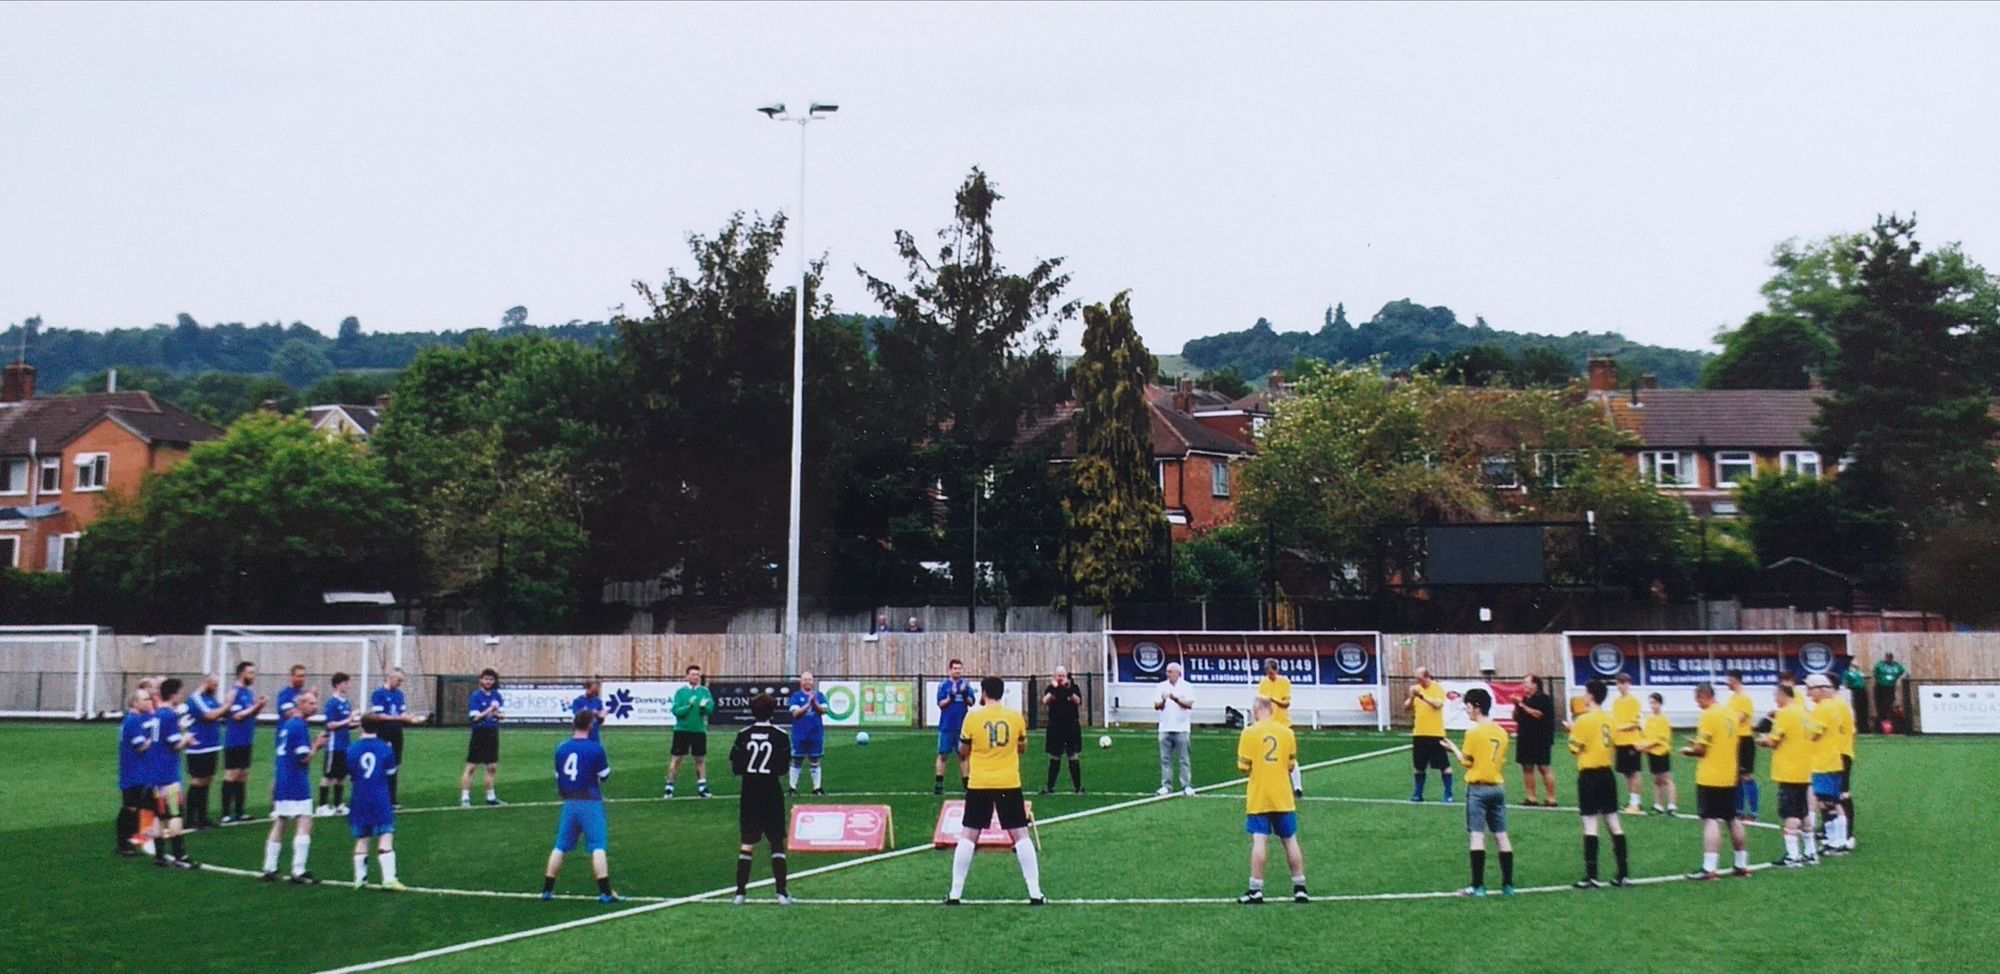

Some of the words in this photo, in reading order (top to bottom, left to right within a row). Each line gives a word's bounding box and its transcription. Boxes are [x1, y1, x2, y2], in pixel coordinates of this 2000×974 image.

[1190, 658, 1215, 670] TEL:
[503, 693, 559, 709] Barkers
[718, 697, 790, 707] STONTE
[983, 720, 1010, 748] 10
[746, 740, 773, 774] 22
[1263, 735, 1278, 762] 2
[1489, 737, 1500, 763] 7
[360, 751, 377, 779] 9
[563, 752, 578, 781] 4
